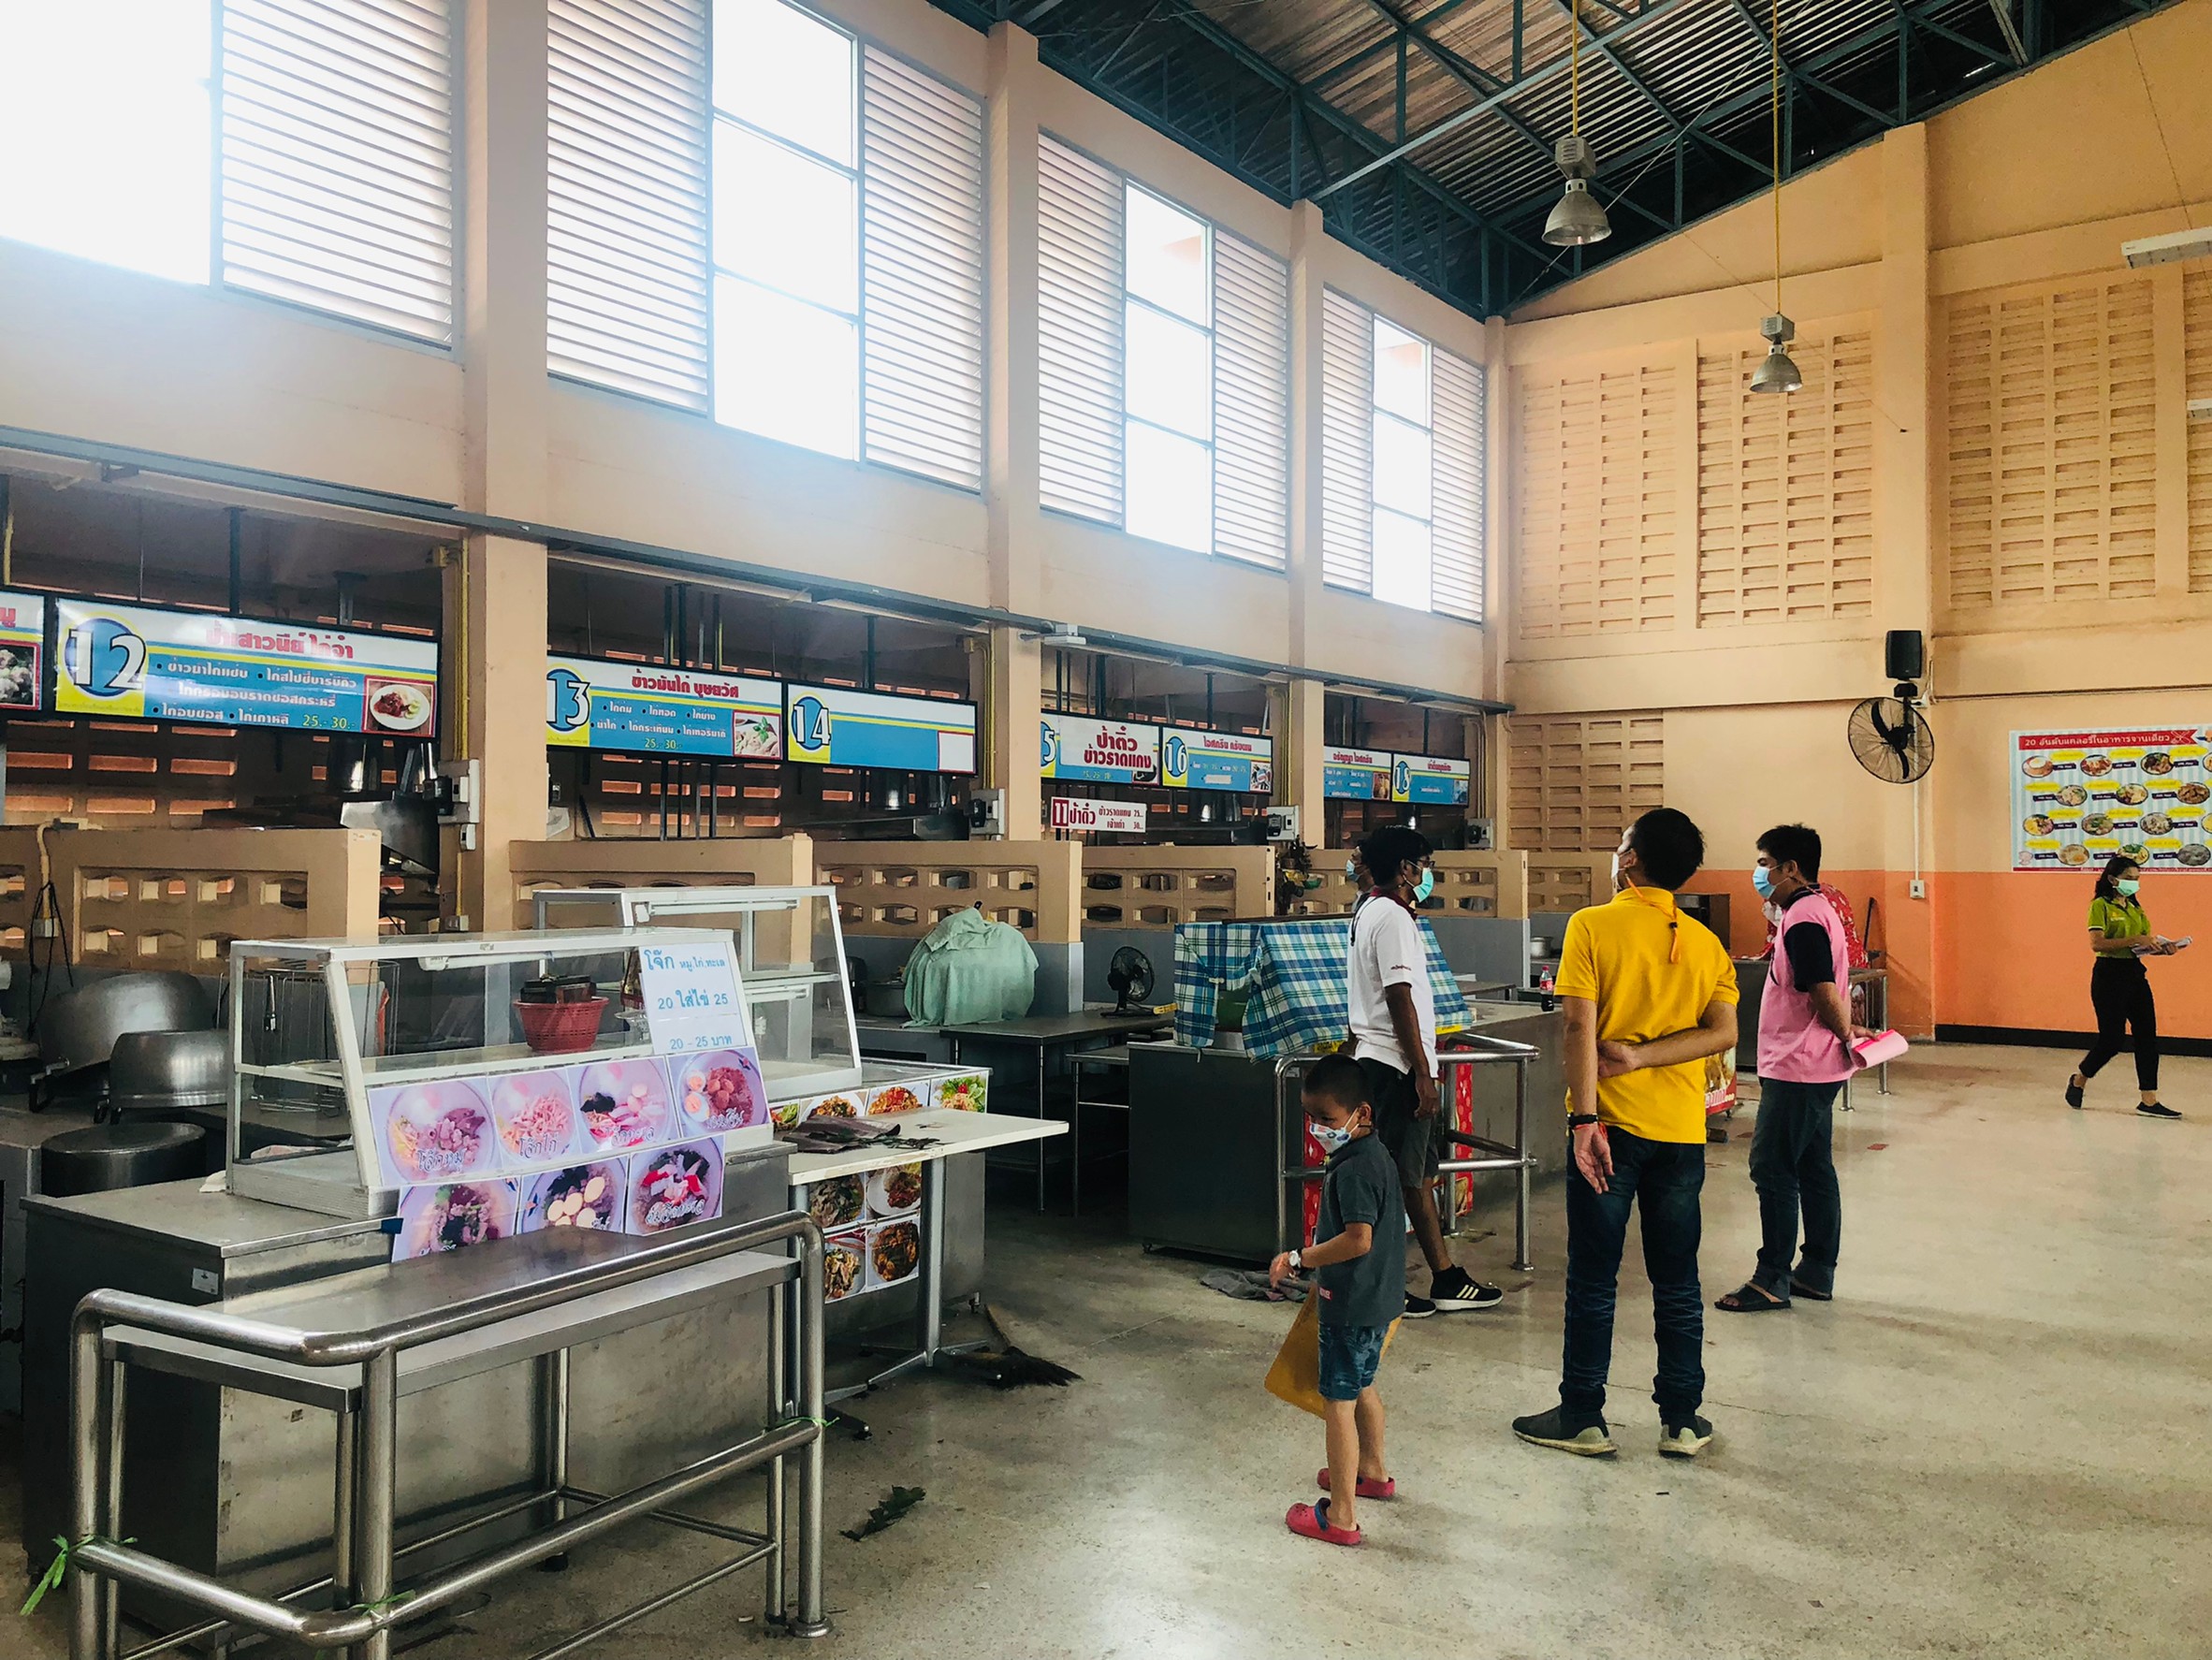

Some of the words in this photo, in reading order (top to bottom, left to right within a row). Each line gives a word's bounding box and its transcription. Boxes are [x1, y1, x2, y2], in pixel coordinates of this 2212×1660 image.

[69, 628, 147, 690] 12
[631, 668, 691, 693] ข้าวมันไก่
[546, 678, 591, 727] 13
[648, 704, 677, 718] ไก่ทอด
[238, 707, 290, 725] ไก่เกาหลี
[793, 704, 832, 745] 14
[1096, 725, 1139, 752] ป้าติ๋ว
[2025, 738, 2037, 747] 20
[1084, 743, 1152, 769] ข้าวราดแกง
[1166, 742, 1188, 774] 16
[1395, 765, 1411, 791] 18
[1070, 802, 1096, 824] ป้าติ๋ว
[644, 949, 675, 970] โจ๊ก
[658, 997, 674, 1010] 20
[675, 988, 709, 1008] ใส่ไข่
[714, 993, 728, 1006] 25
[669, 1038, 684, 1050] 20
[695, 1036, 708, 1047] 25
[711, 1035, 732, 1046] บาท
